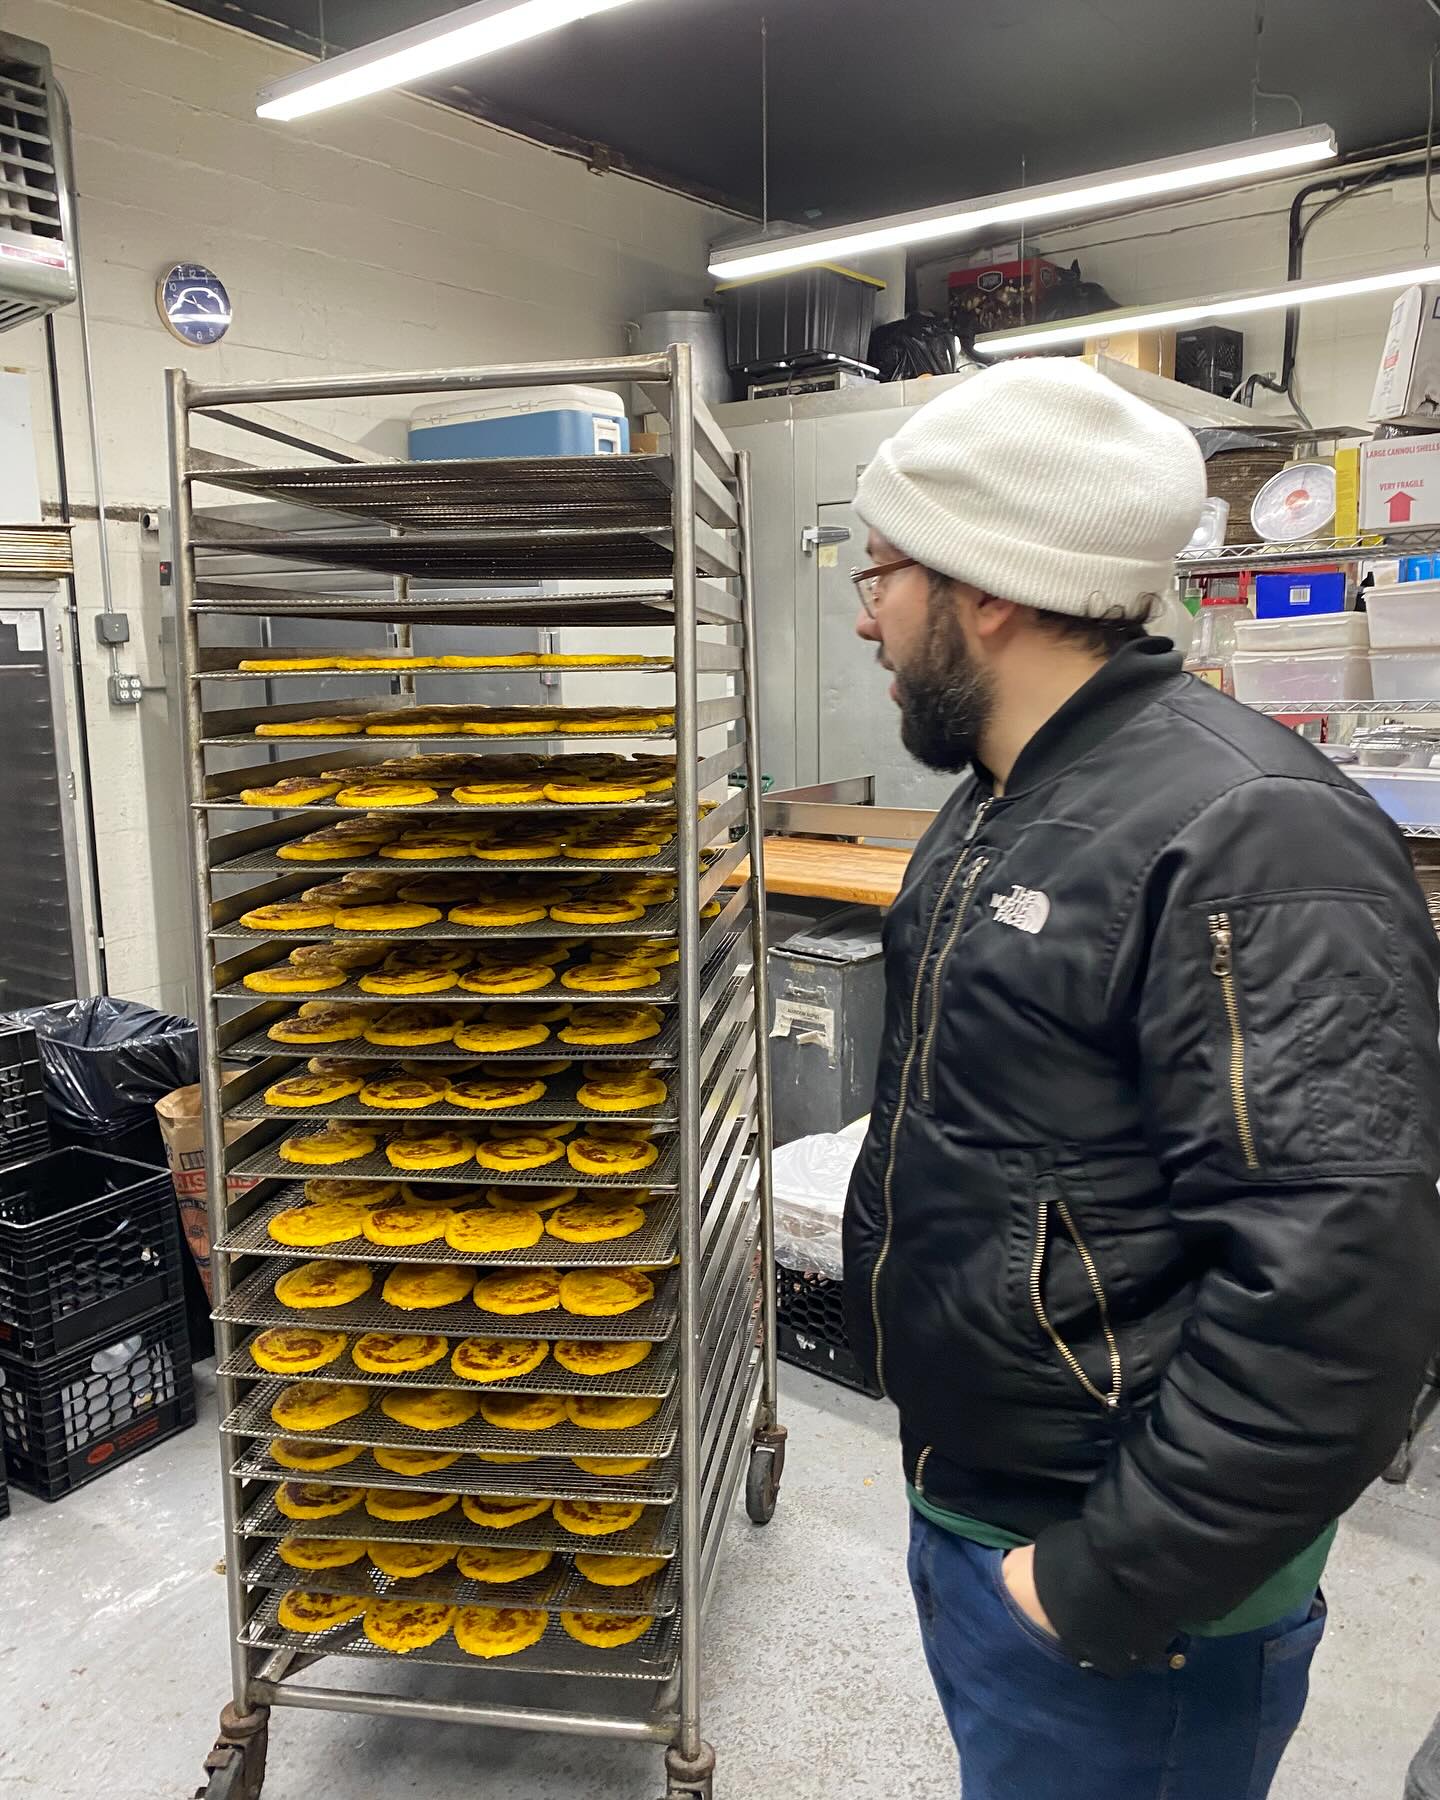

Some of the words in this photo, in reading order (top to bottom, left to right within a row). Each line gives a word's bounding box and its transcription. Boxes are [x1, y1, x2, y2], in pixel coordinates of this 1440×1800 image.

[1366, 449, 1386, 458] LARGE
[1387, 446, 1415, 456] CANNOLI
[1415, 443, 1440, 453] SHELLS
[1380, 482, 1396, 491] VERY
[1397, 479, 1424, 489] FRAGILE
[1011, 885, 1039, 903] THE
[989, 893, 1033, 918] NORTH
[993, 908, 1026, 930] FACE
